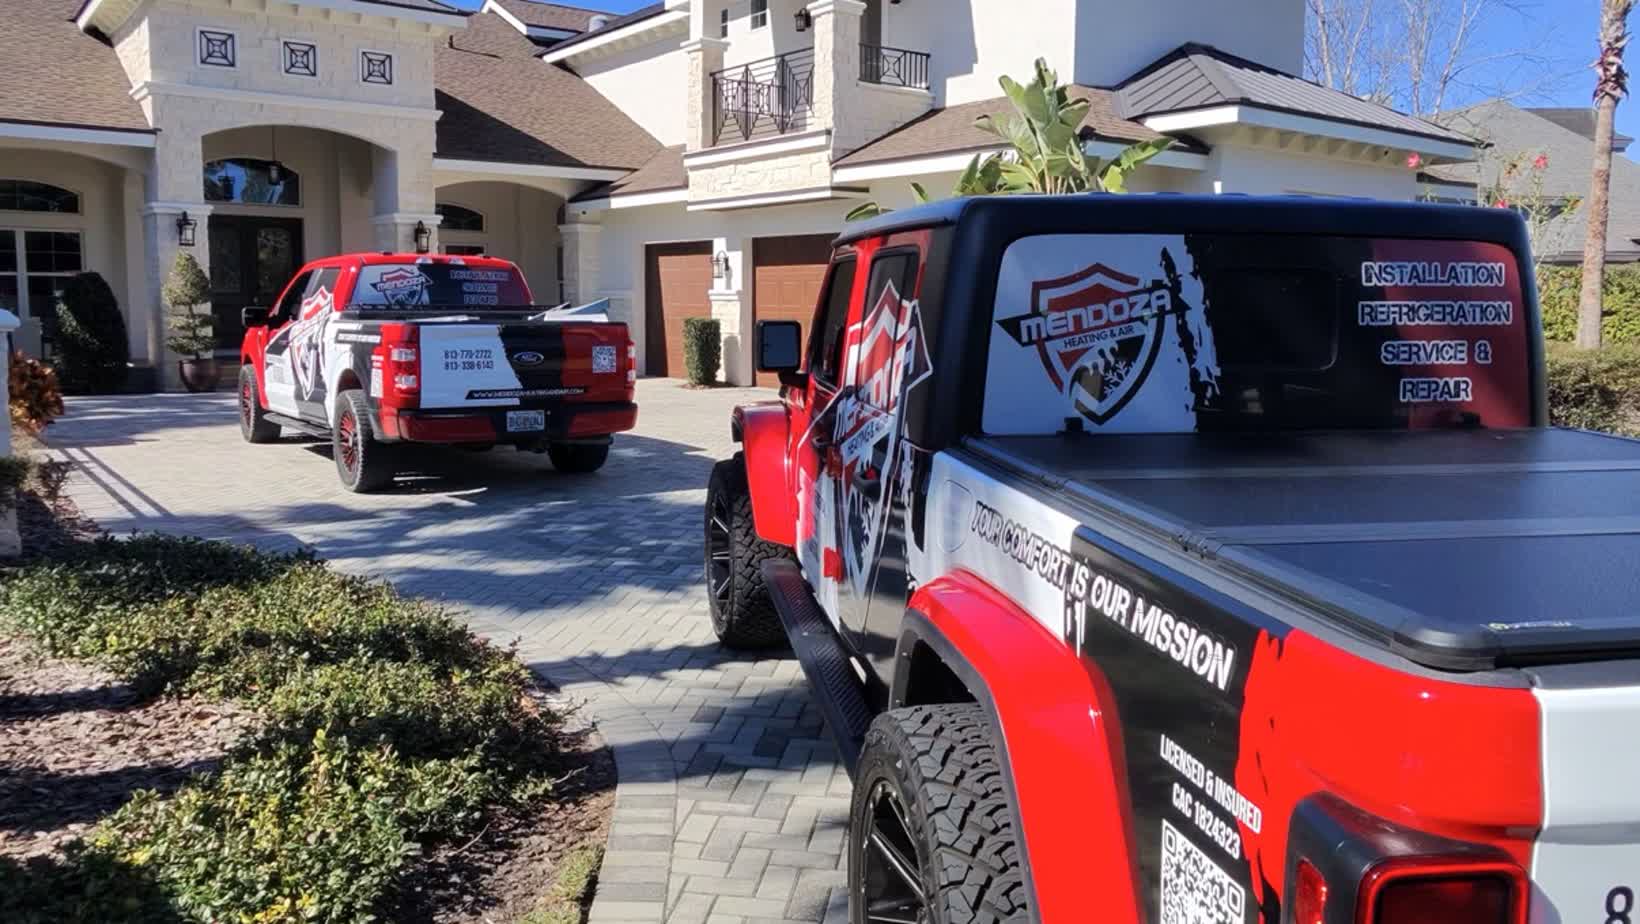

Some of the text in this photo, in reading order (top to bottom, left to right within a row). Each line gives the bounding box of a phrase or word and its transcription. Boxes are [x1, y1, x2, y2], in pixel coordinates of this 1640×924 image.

[377, 276, 425, 291] MENDOZA
[1362, 262, 1505, 286] INSTALLATION
[1020, 289, 1171, 343] MENDOZA
[1358, 301, 1512, 325] REFRIGERATION
[1064, 325, 1135, 348] HEATING & AIR
[1381, 340, 1492, 364] SERVICE &
[1400, 378, 1472, 402] REPAIR
[971, 500, 1235, 691] YOUR COMFORT IS OUR MISSION
[1160, 733, 1262, 834] LICENSED & INSURED
[1172, 782, 1240, 860] CAC 1824323
